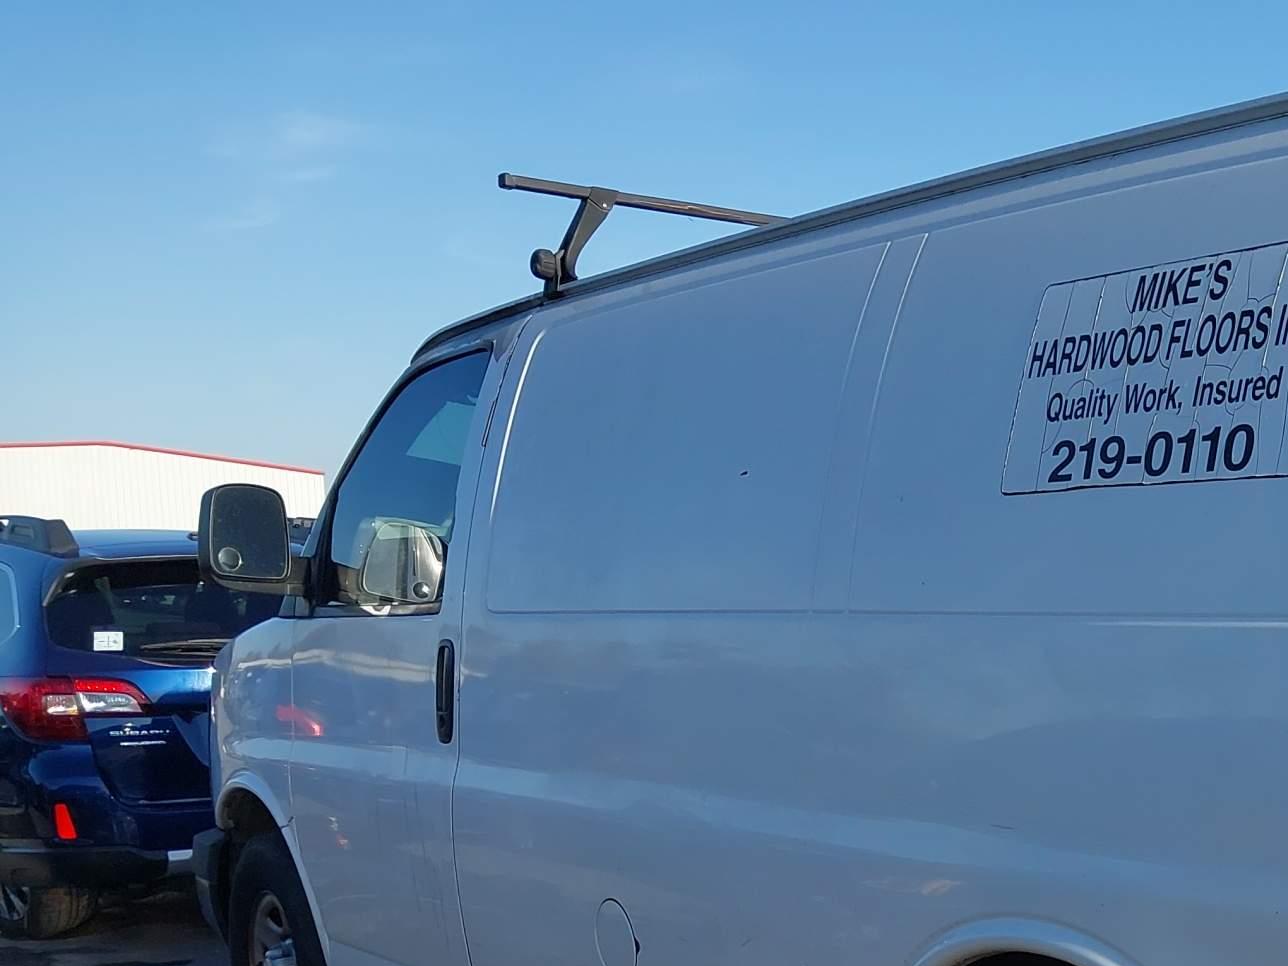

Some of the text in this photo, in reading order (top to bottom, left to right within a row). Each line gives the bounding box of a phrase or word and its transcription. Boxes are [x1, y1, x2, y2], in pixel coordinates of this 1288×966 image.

[1132, 259, 1232, 313] MIKE'S
[1028, 324, 1162, 378] HARDWOOD
[1166, 306, 1273, 361] FLOORS
[1046, 367, 1283, 424] Quality Work, Insured
[1048, 424, 1255, 483] 219-0110
